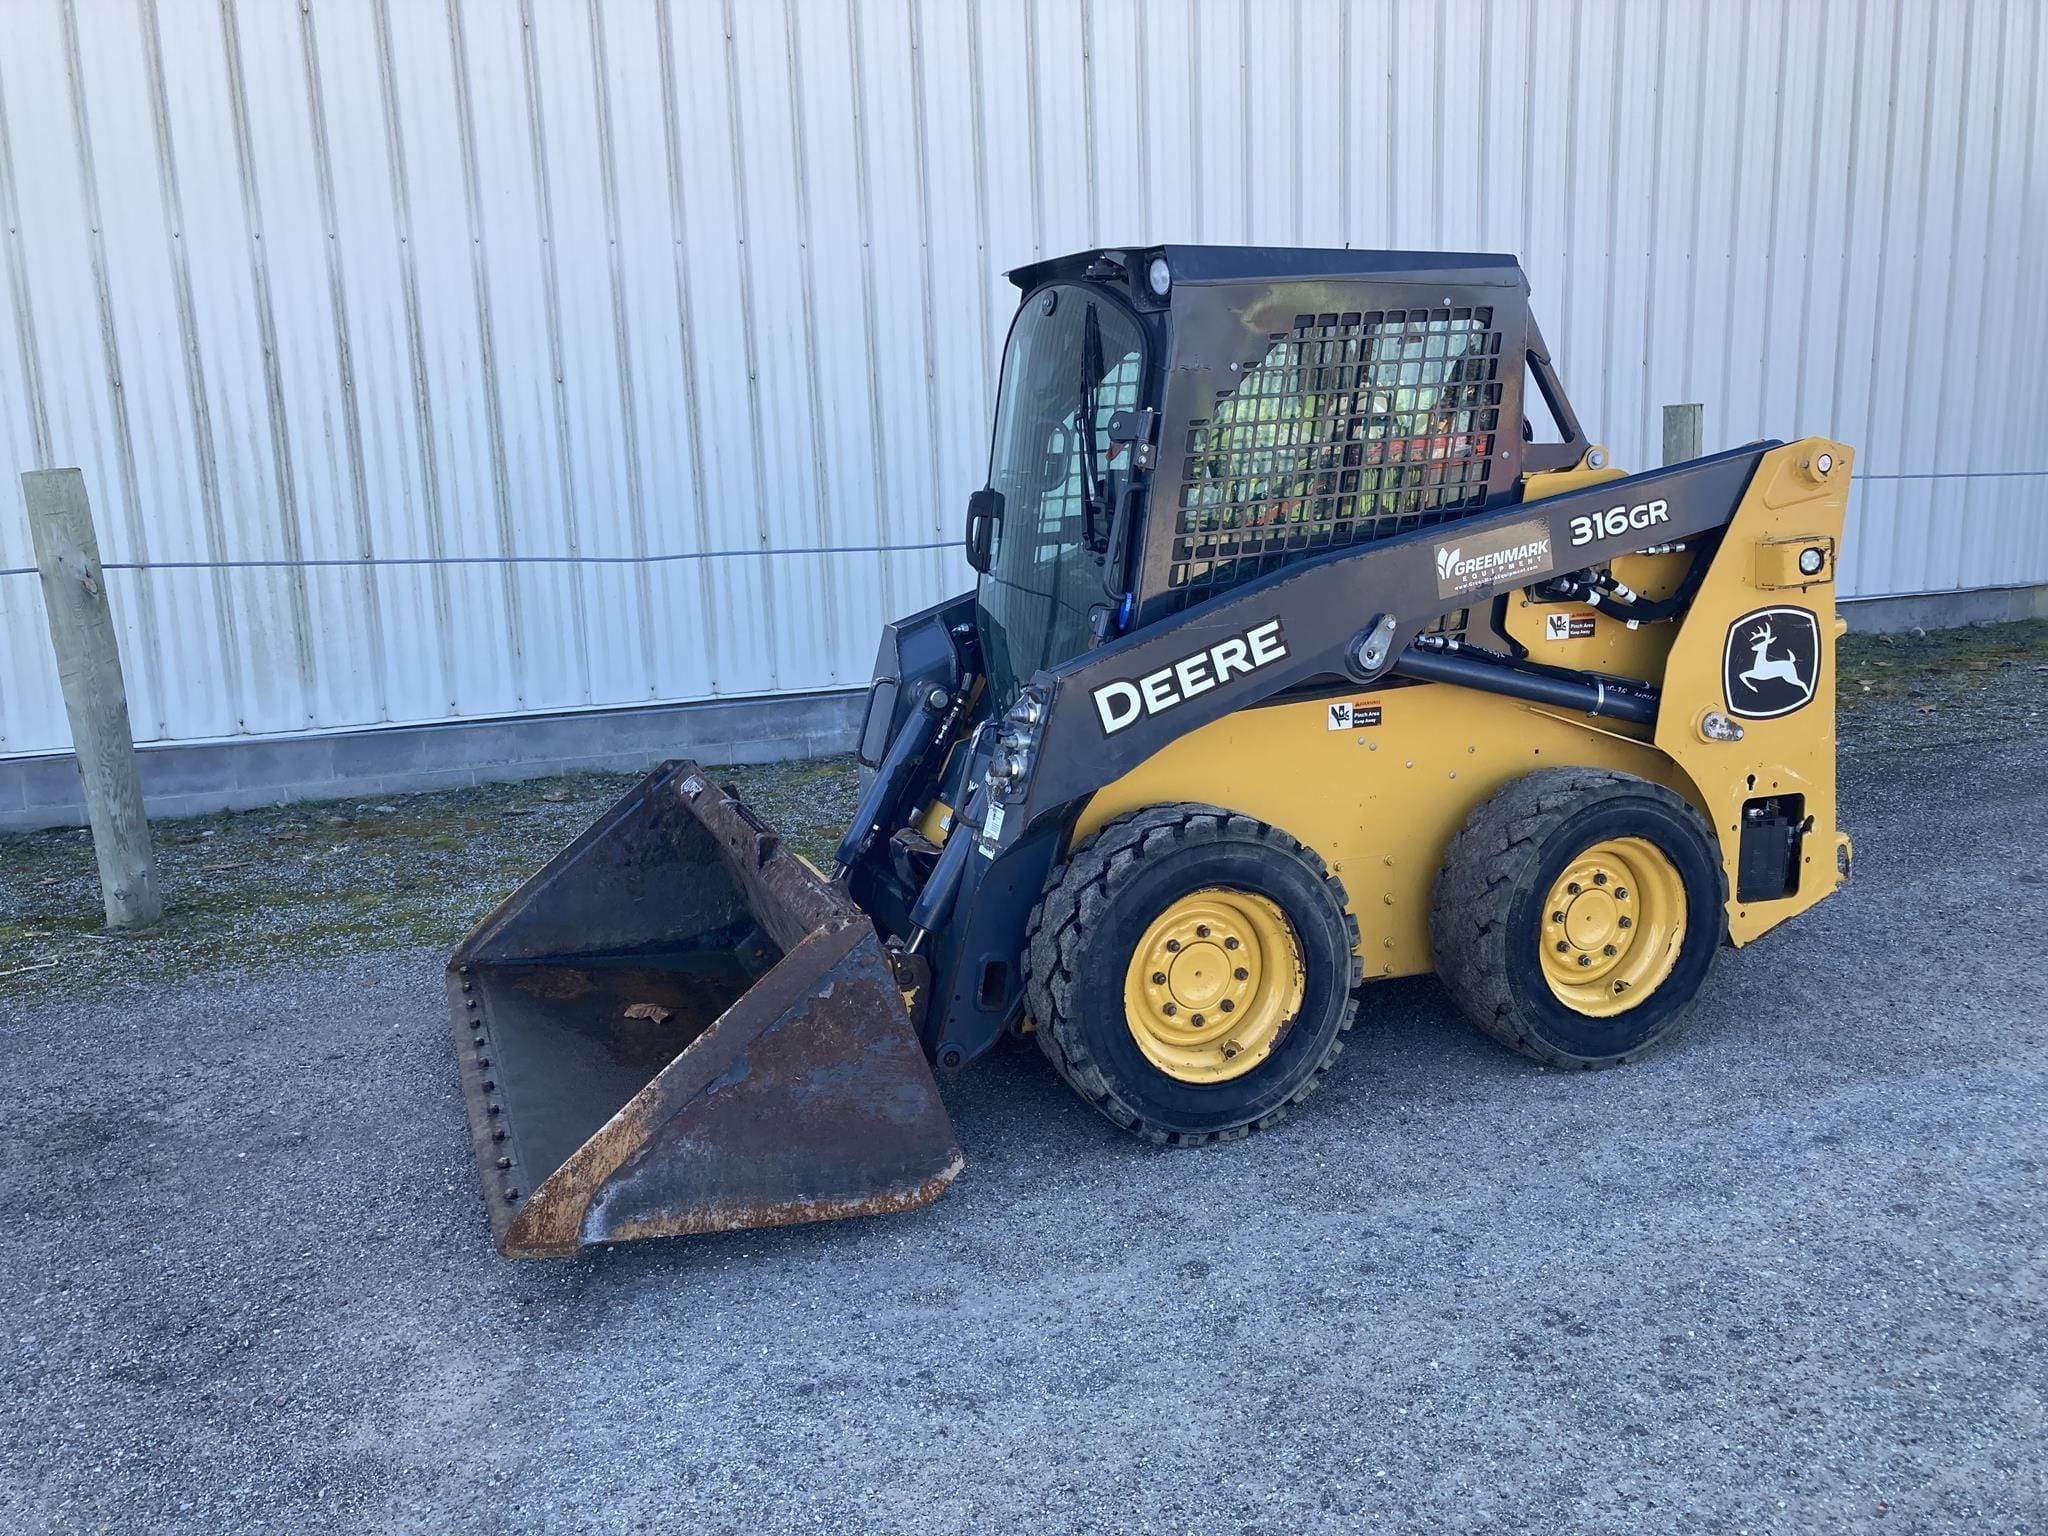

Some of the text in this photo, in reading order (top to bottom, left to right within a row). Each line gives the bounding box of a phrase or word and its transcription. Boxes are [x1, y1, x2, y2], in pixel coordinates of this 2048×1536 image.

[1570, 499, 1669, 546] 316GR
[1454, 539, 1549, 576] GREENMARK
[1462, 556, 1542, 582] EQUIPMENT
[1093, 620, 1287, 734] DEERE
